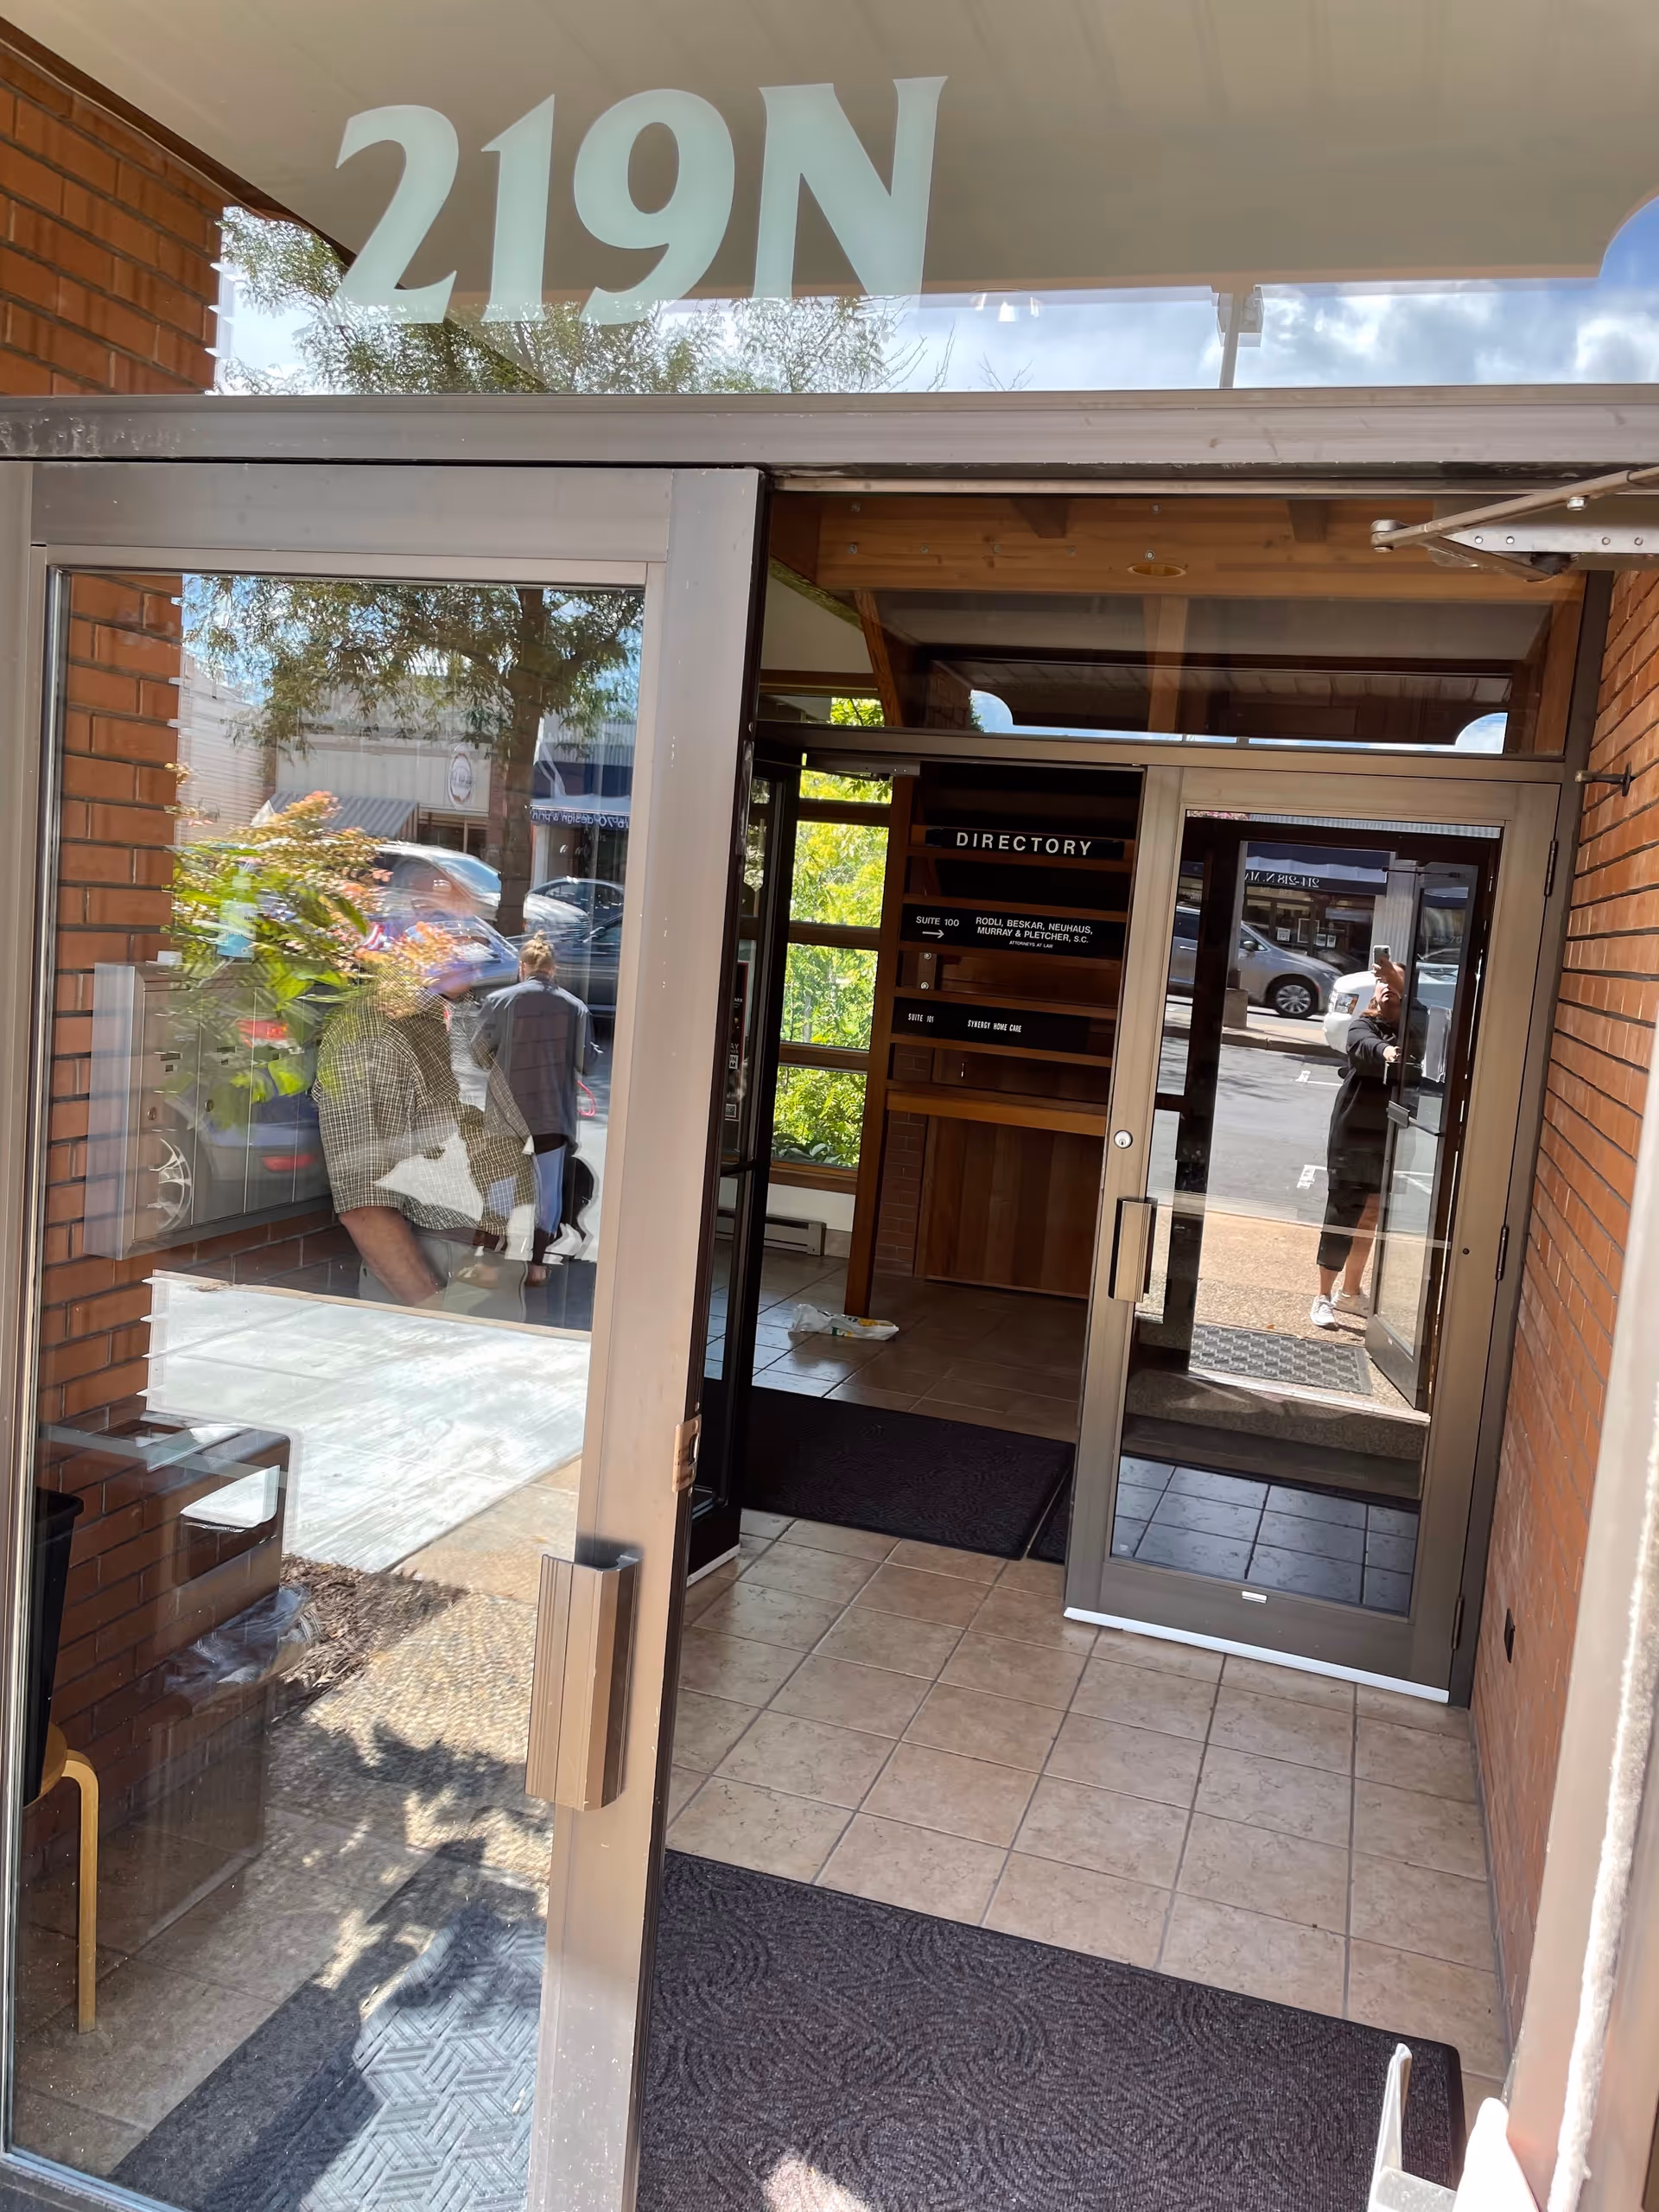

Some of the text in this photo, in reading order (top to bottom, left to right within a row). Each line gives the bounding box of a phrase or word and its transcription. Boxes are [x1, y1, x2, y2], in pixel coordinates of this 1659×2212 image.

[334, 74, 949, 327] 219N
[956, 832, 1091, 856] DIRECTORY
[916, 916, 960, 927] SUITE 100
[976, 917, 1093, 936] RODLI, BESKAR, NEUHAUS,
[976, 926, 1089, 944] MURRAY & PLETCHER, S.C.
[907, 1013, 924, 1023] SUITE
[967, 1020, 1022, 1033] SYNERGY HOME CARE
